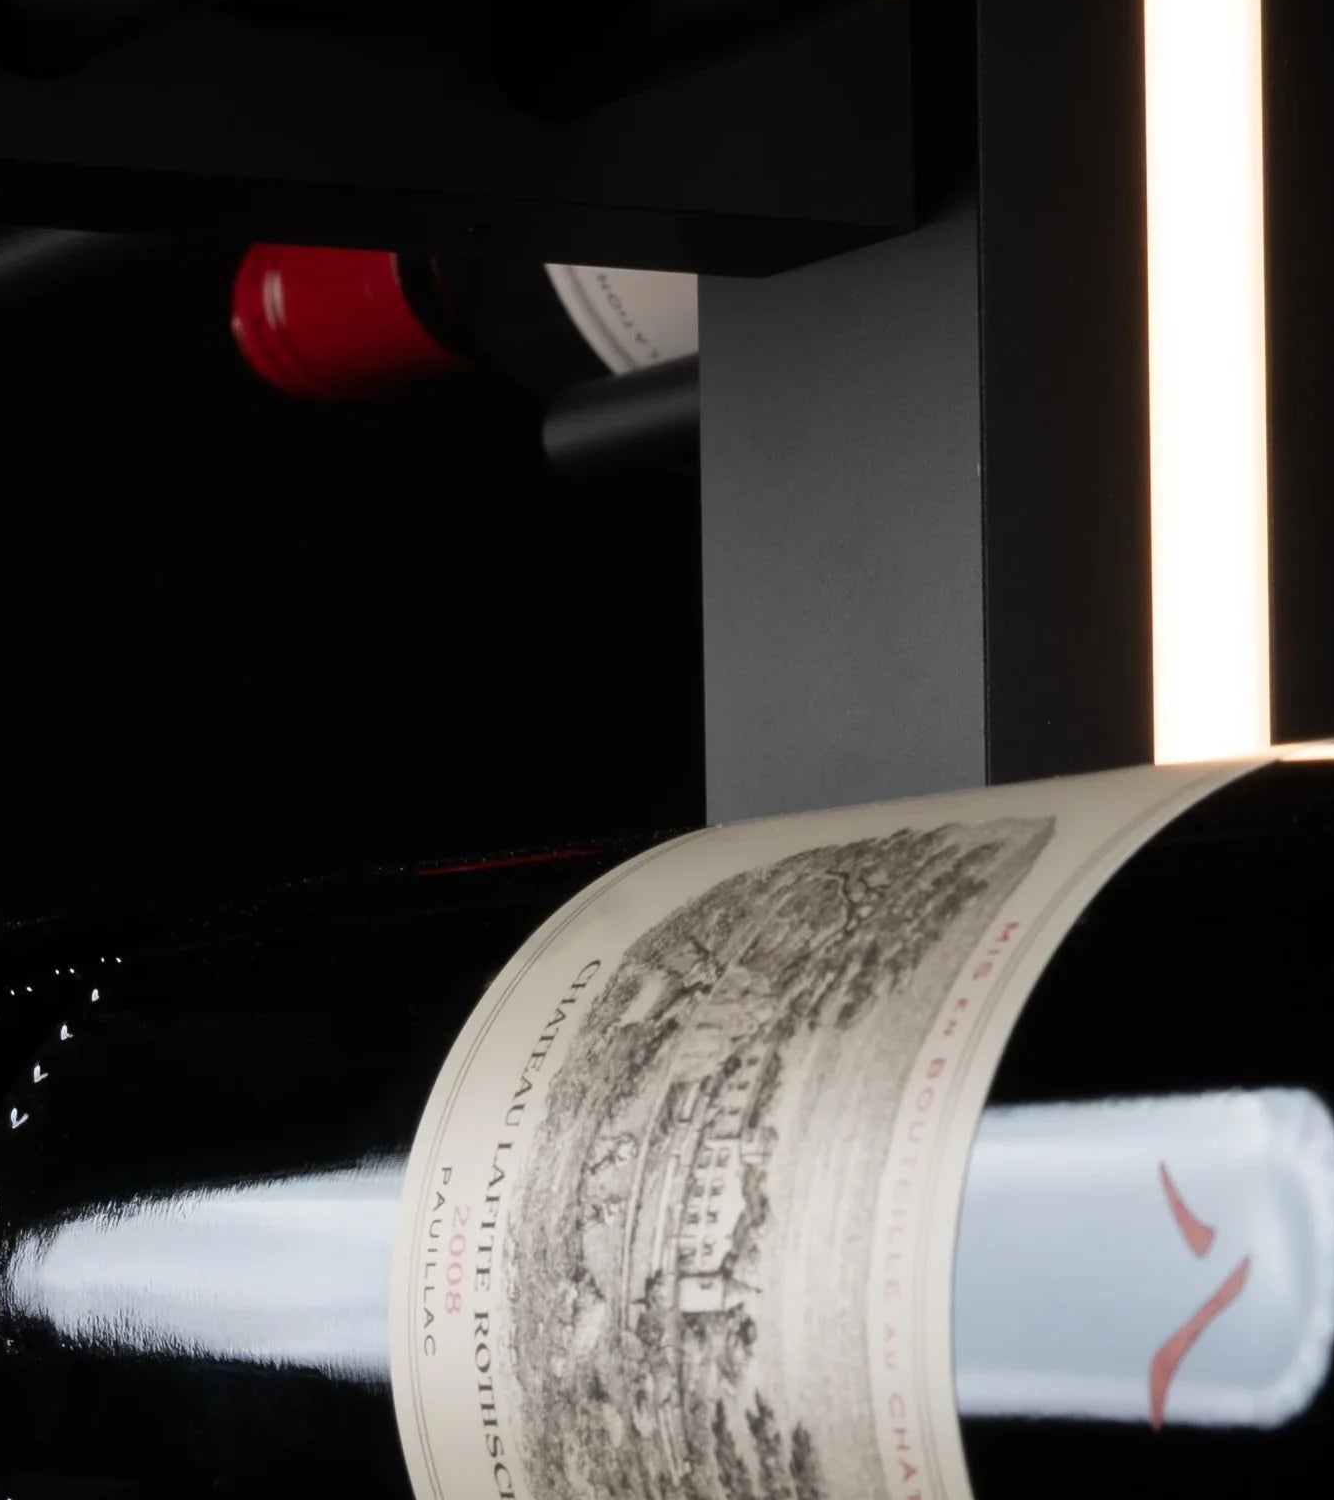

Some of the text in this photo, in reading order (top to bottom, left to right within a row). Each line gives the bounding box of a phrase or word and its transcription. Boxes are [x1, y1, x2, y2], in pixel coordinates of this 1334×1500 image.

[504, 958, 602, 1127] CHATEAU
[422, 1166, 452, 1358] PAUILLAC
[443, 1204, 472, 1315] 2008
[473, 1143, 513, 1292] LAFITE
